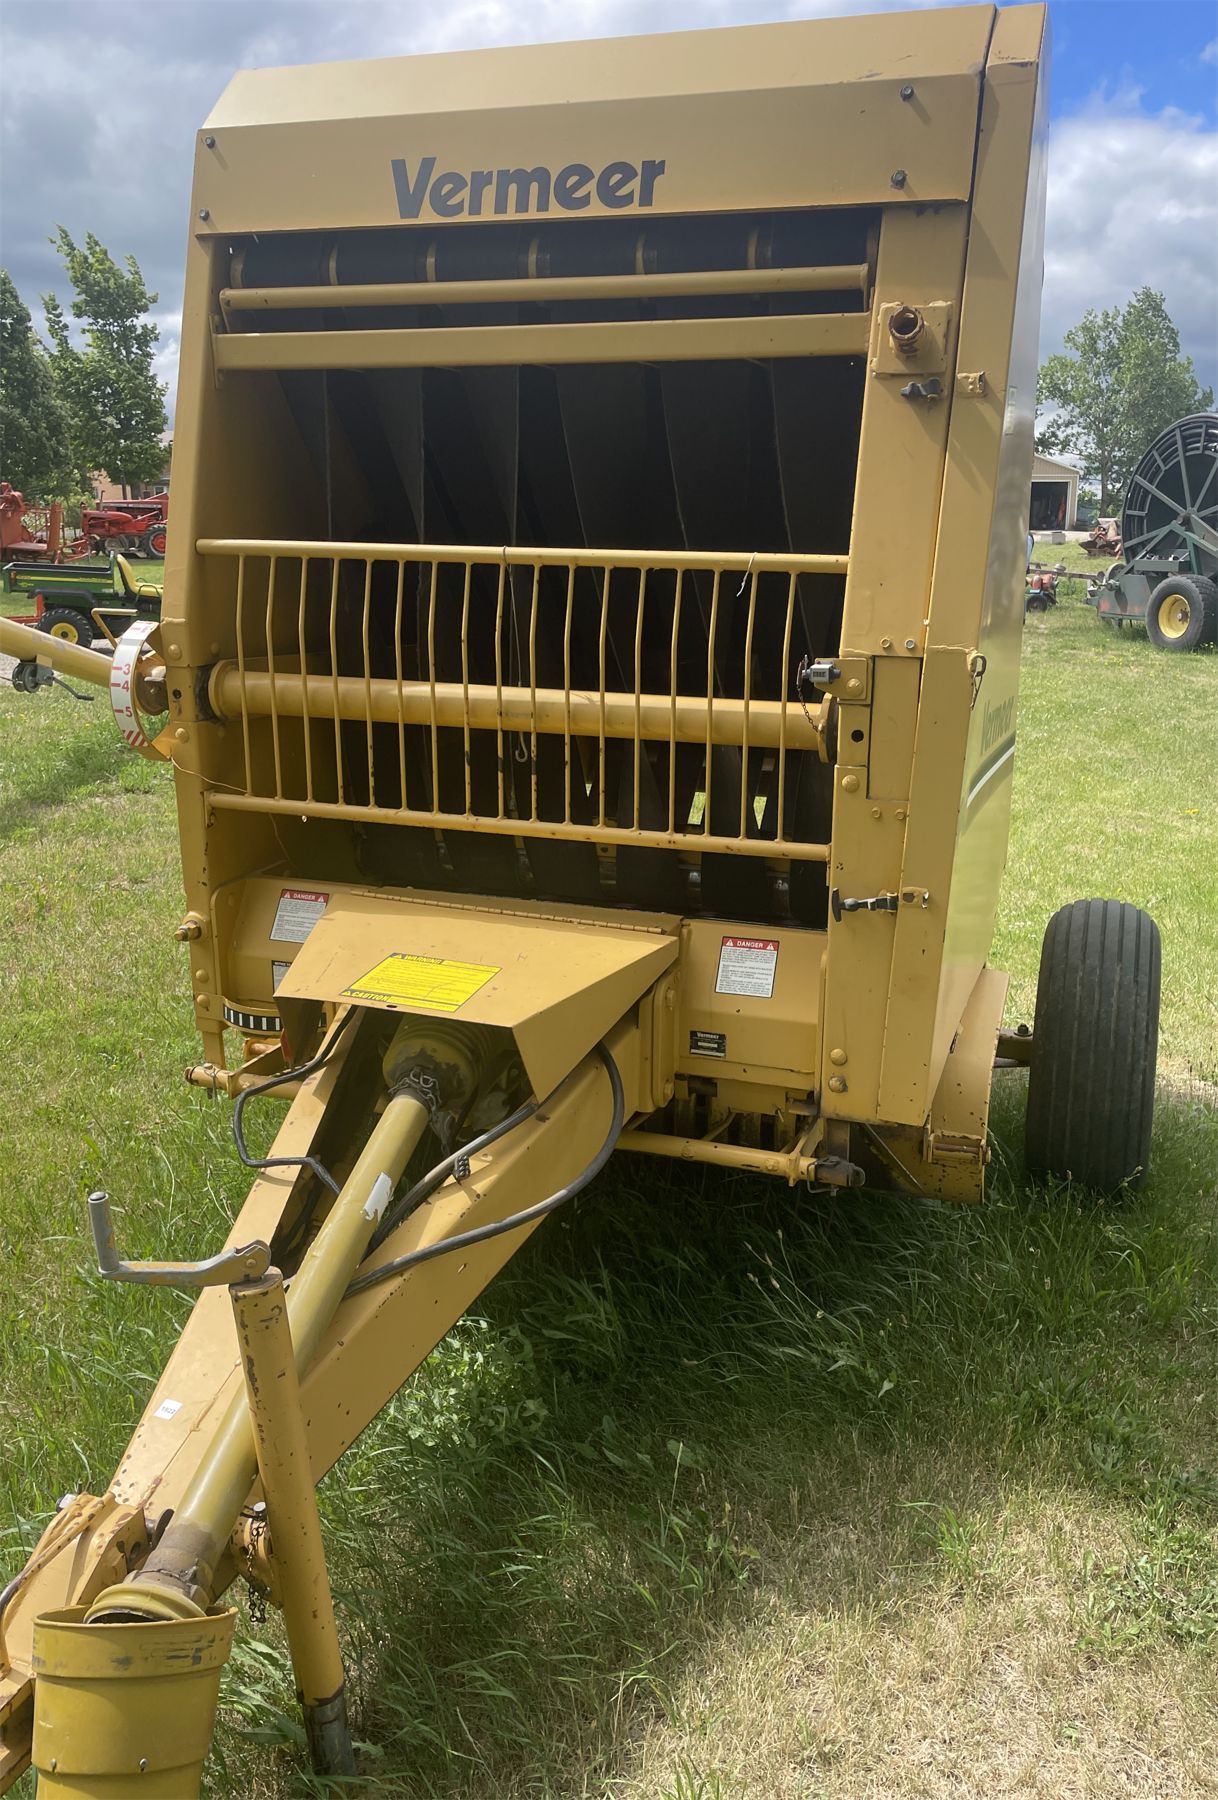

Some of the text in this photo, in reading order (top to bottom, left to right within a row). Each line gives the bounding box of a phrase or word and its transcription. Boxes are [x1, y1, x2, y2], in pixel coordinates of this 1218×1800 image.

[391, 157, 666, 219] Vermeer
[123, 664, 131, 675] 3
[122, 680, 129, 692] 4
[125, 706, 132, 717] 5
[737, 940, 763, 948] DANGER
[405, 954, 442, 964] WARNING
[352, 991, 390, 1002] CAUTION
